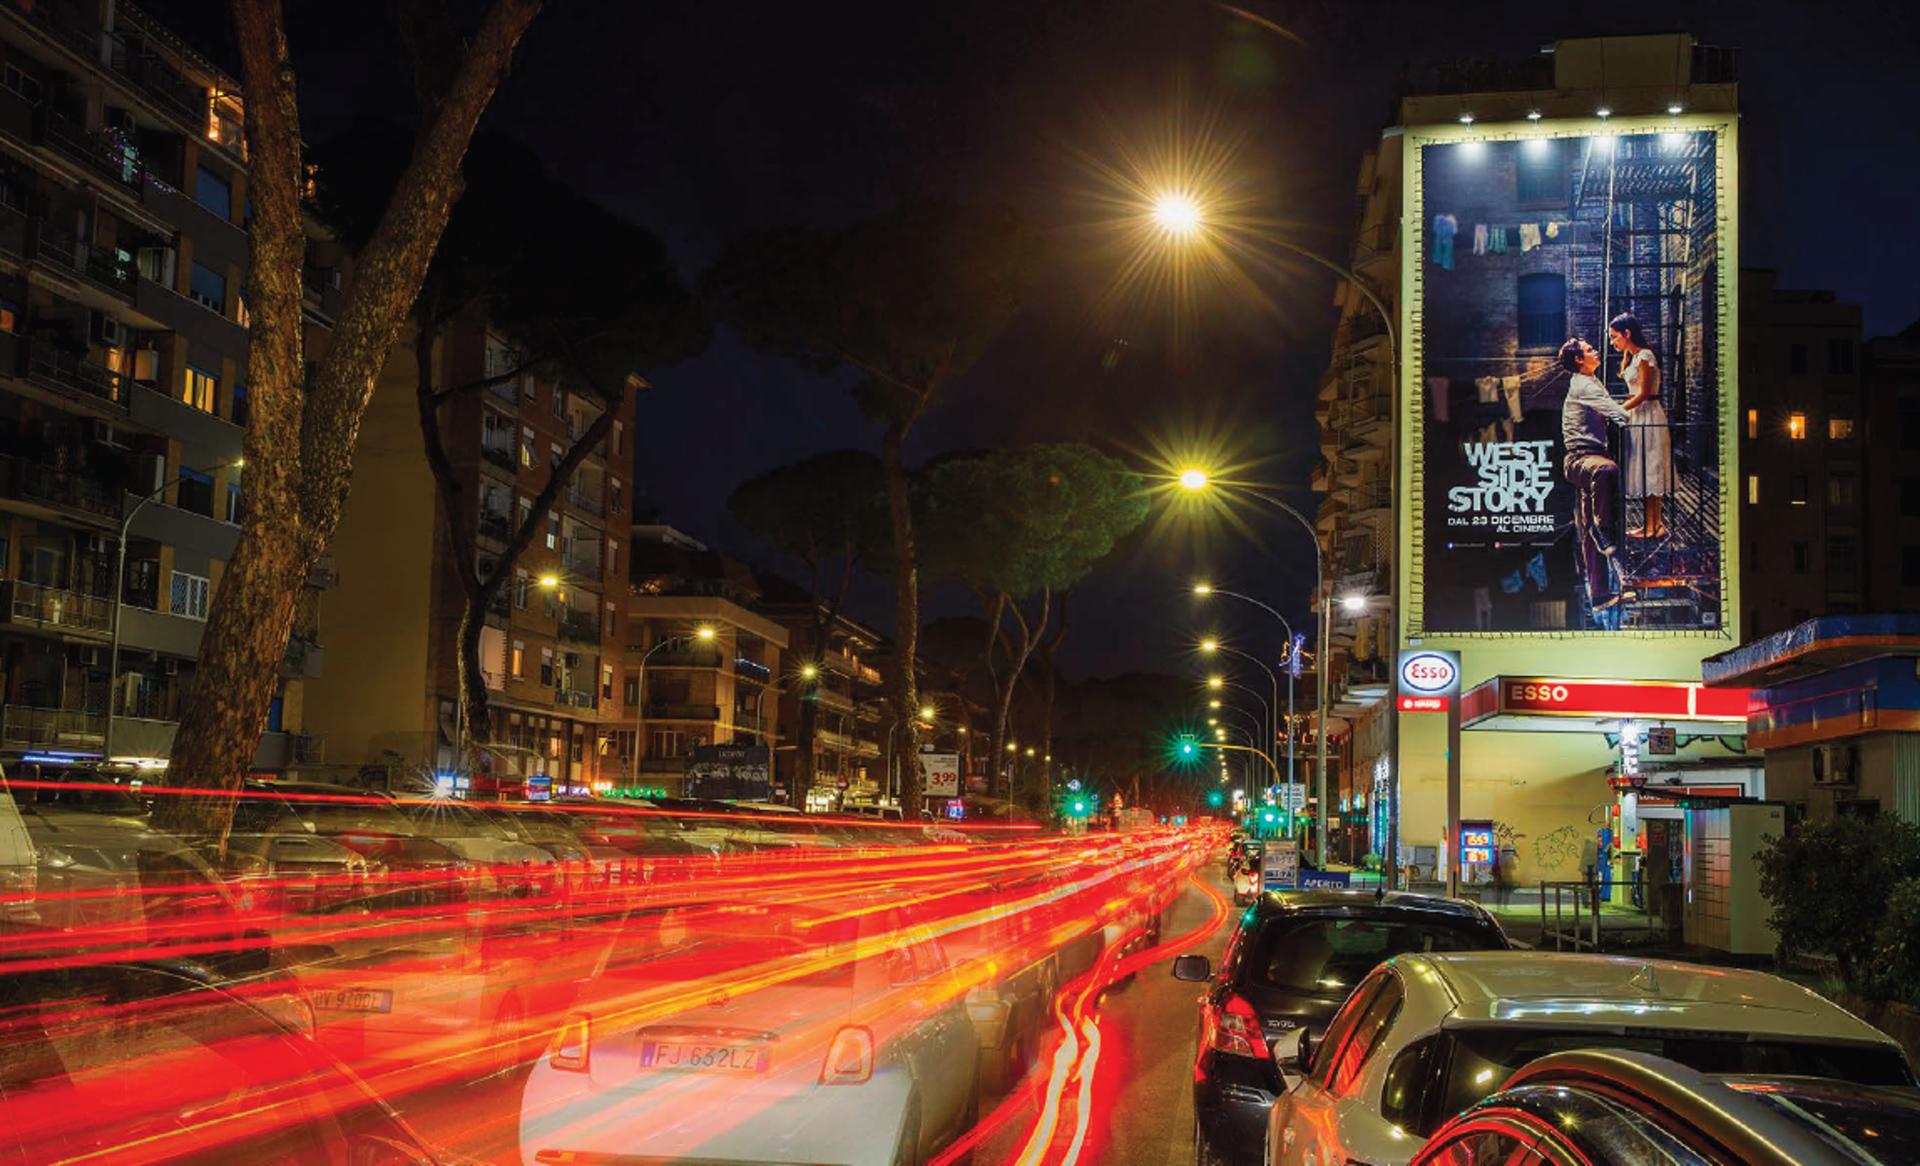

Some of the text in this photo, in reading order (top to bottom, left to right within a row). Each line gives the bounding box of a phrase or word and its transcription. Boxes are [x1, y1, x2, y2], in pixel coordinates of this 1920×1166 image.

[1463, 440, 1554, 467] WEST
[1478, 460, 1553, 488] SIDE
[1447, 481, 1554, 513] STORY
[1447, 515, 1554, 526] DAL 23 DICEMBRE
[1496, 525, 1554, 533] AL CINEMA
[1511, 685, 1568, 701] ESSO
[932, 772, 957, 787] 3,99
[656, 1045, 756, 1069] FJ 632LZ
